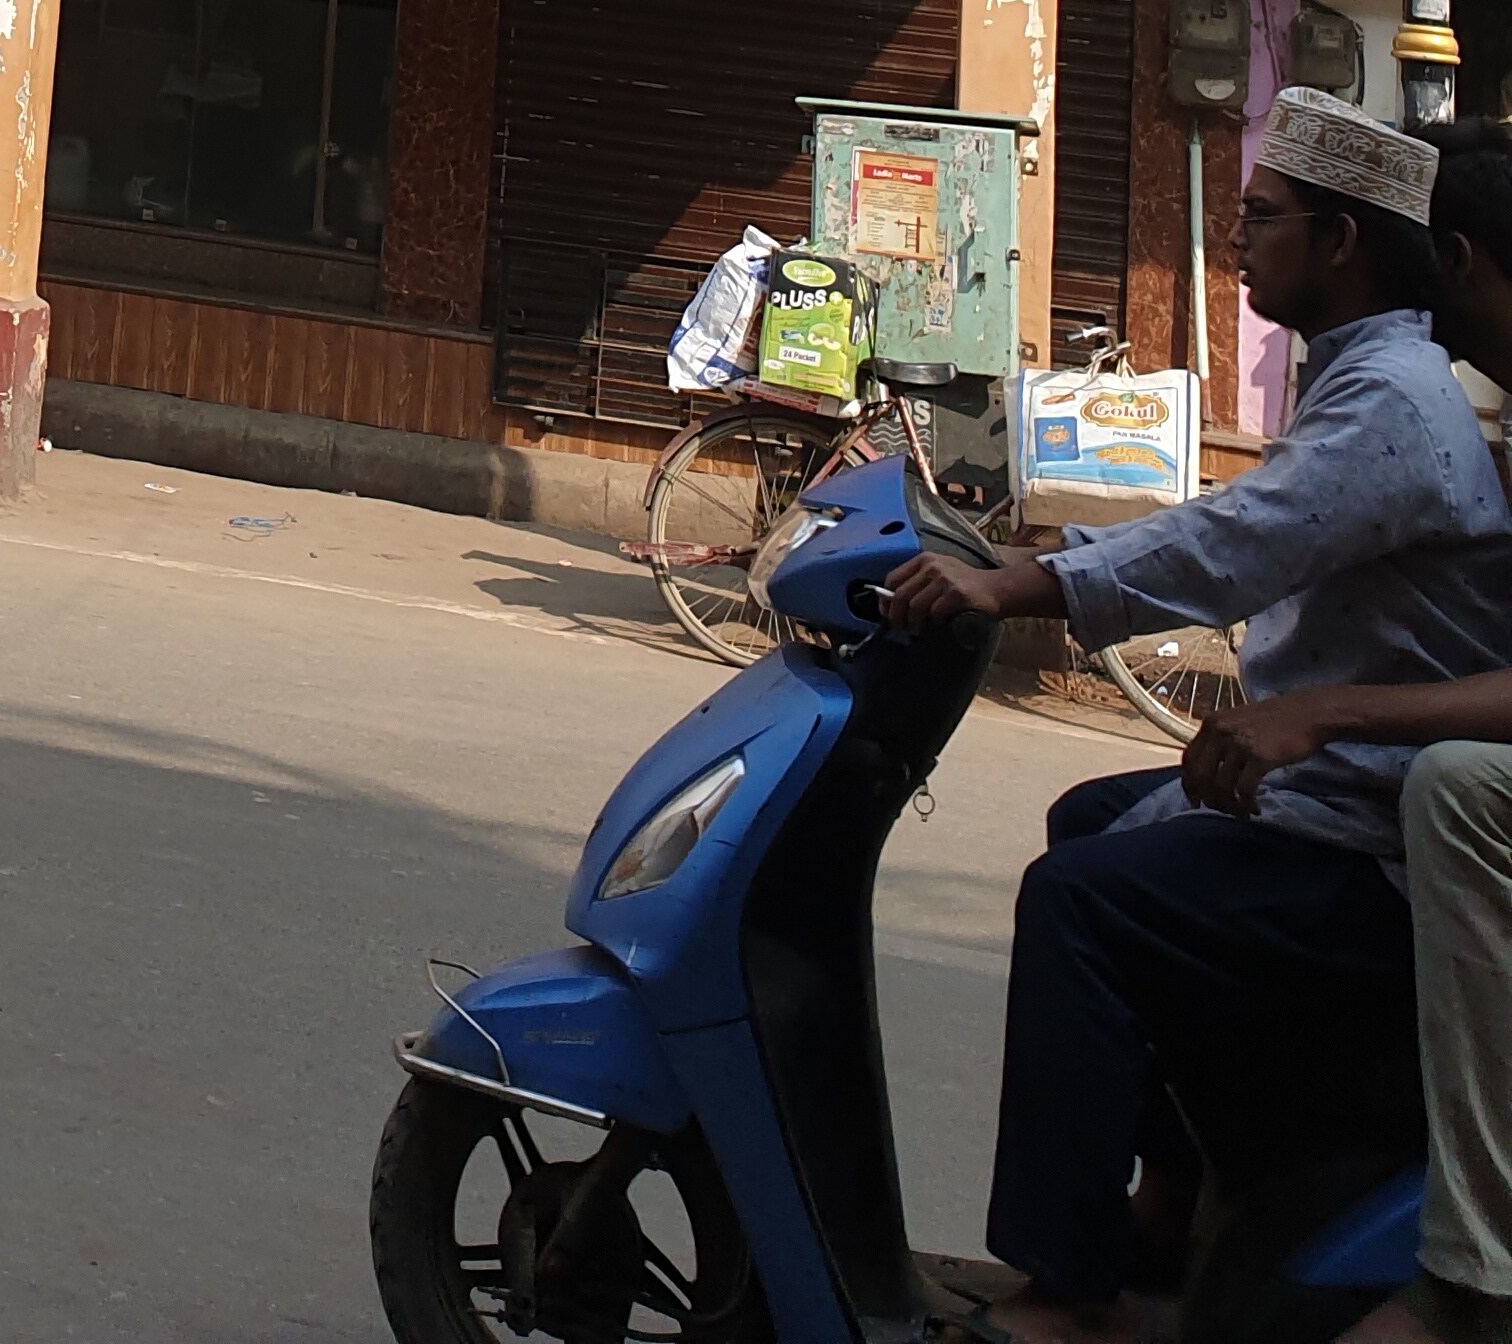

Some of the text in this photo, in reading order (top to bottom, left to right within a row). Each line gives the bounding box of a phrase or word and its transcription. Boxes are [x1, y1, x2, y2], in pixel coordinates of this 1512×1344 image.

[771, 289, 827, 311] PLUSS
[1092, 400, 1156, 420] Gokul
[1112, 430, 1162, 442] PAN MASALA
